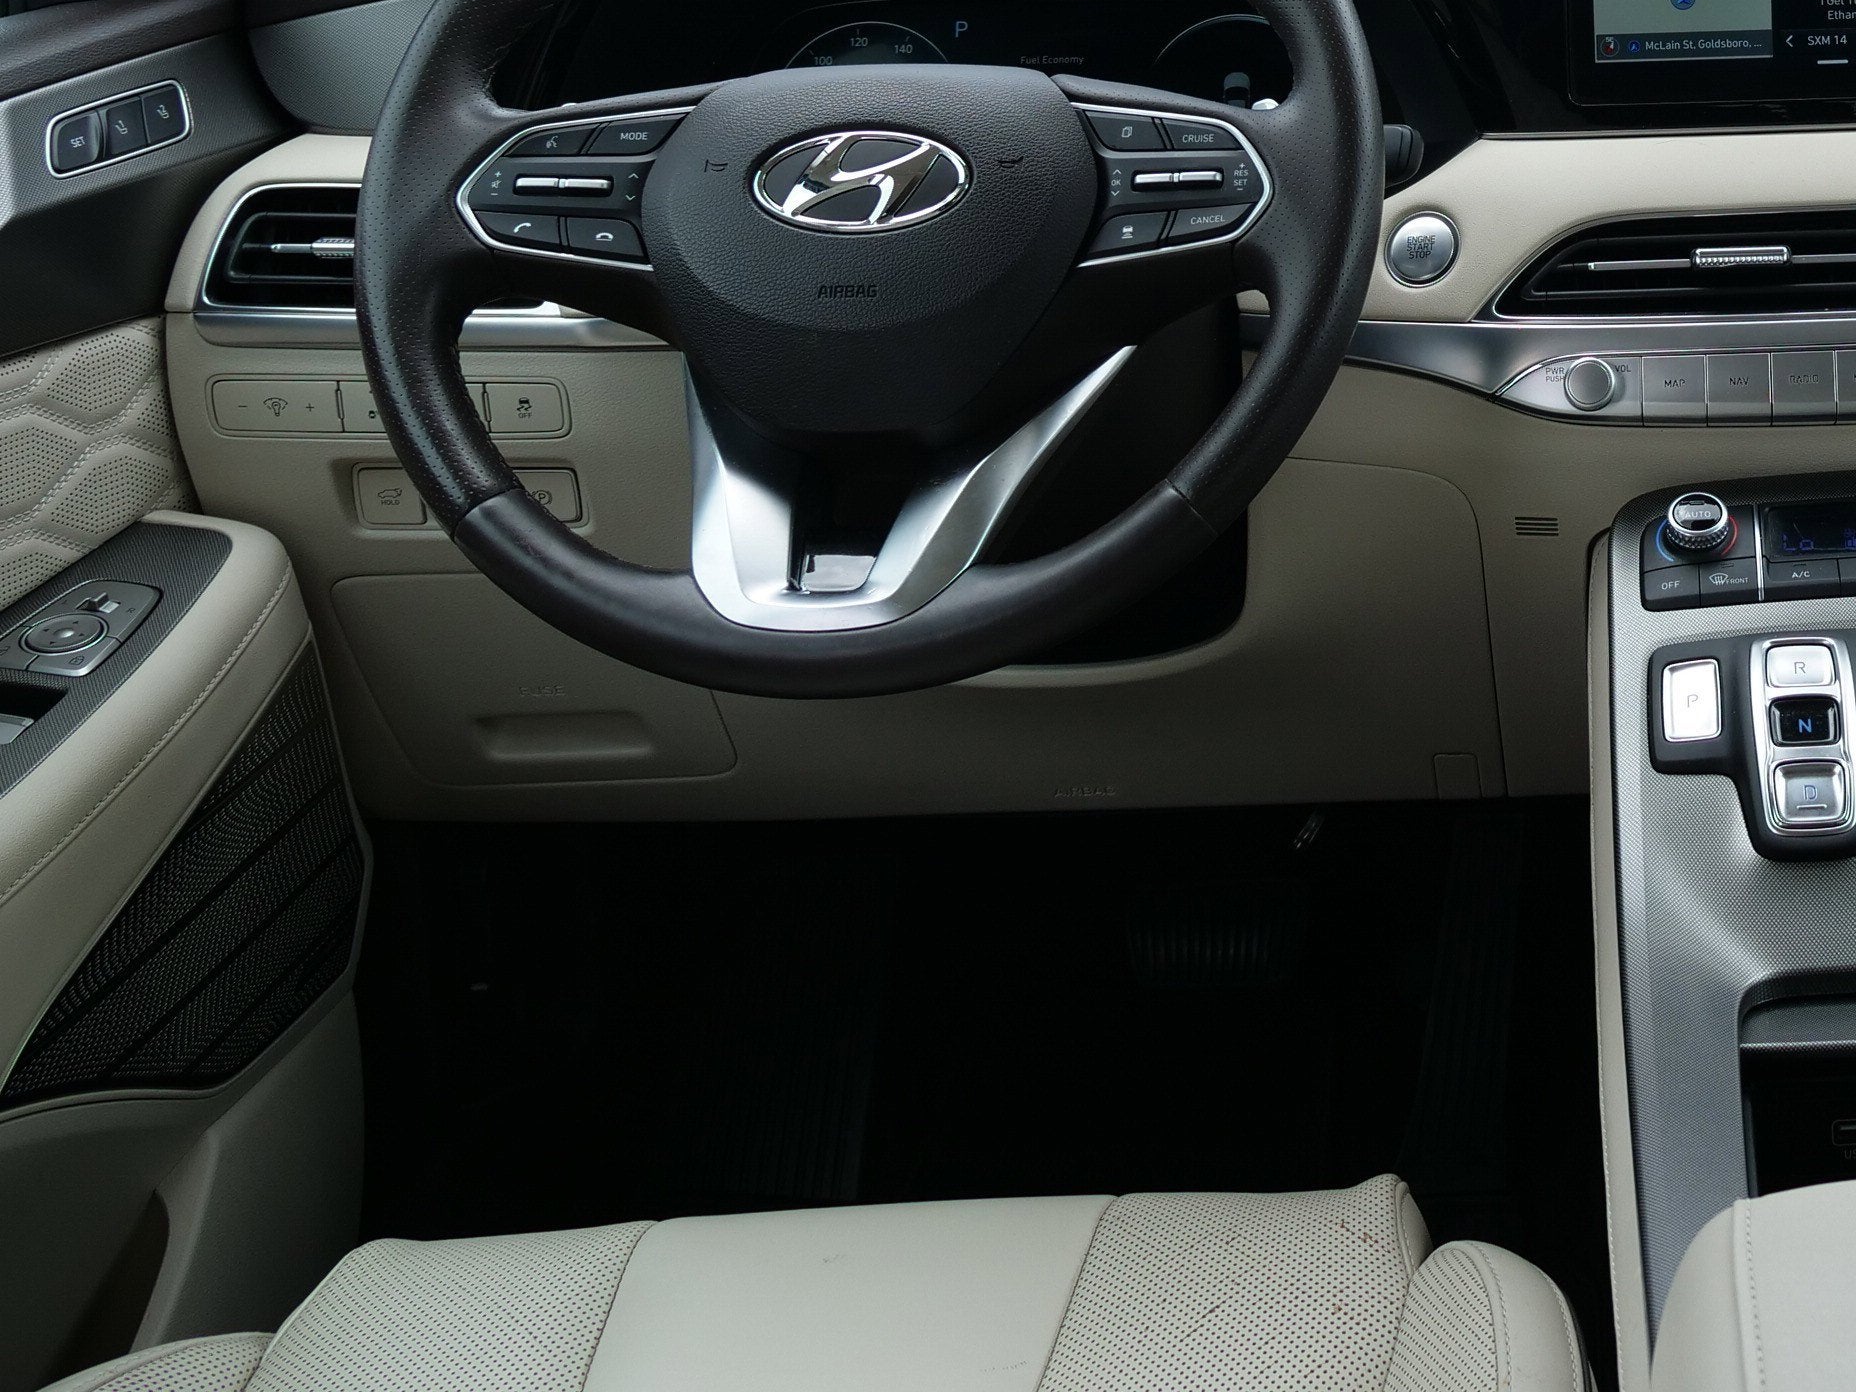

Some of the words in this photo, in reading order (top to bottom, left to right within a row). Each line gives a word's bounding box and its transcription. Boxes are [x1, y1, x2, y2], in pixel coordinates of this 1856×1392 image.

[954, 21, 969, 38] P
[850, 37, 868, 48] 120
[1645, 40, 1681, 51] McLain
[1807, 36, 1831, 46] SXM
[1834, 35, 1848, 45] 14
[894, 44, 913, 54] 140
[813, 56, 833, 67] 100
[1020, 56, 1040, 65] Fuel
[1042, 56, 1085, 67] Economy
[70, 136, 86, 148] SET
[620, 131, 648, 142] MODE
[1182, 133, 1215, 143] CRUISE
[1233, 169, 1249, 177] RES
[1233, 178, 1248, 186] SET
[1190, 214, 1226, 225] CANCEL
[1407, 235, 1436, 244] ENGINE
[1406, 242, 1435, 252] START
[1408, 250, 1432, 259] STOP
[817, 285, 879, 299] AIRBAG
[1545, 366, 1565, 376] PWR
[1614, 363, 1632, 373] VOL
[1545, 374, 1565, 383] PUSH
[1663, 378, 1686, 388] MAP
[1728, 377, 1750, 387] NAV
[1789, 374, 1820, 385] RADIO
[1684, 510, 1712, 519] AUTO
[1791, 570, 1810, 579] A/C
[1661, 580, 1680, 591] OFF
[1726, 576, 1749, 585] FRONT
[1793, 661, 1806, 675] R
[1686, 693, 1699, 708] P
[1798, 718, 1812, 733] N
[1803, 784, 1818, 800] D
